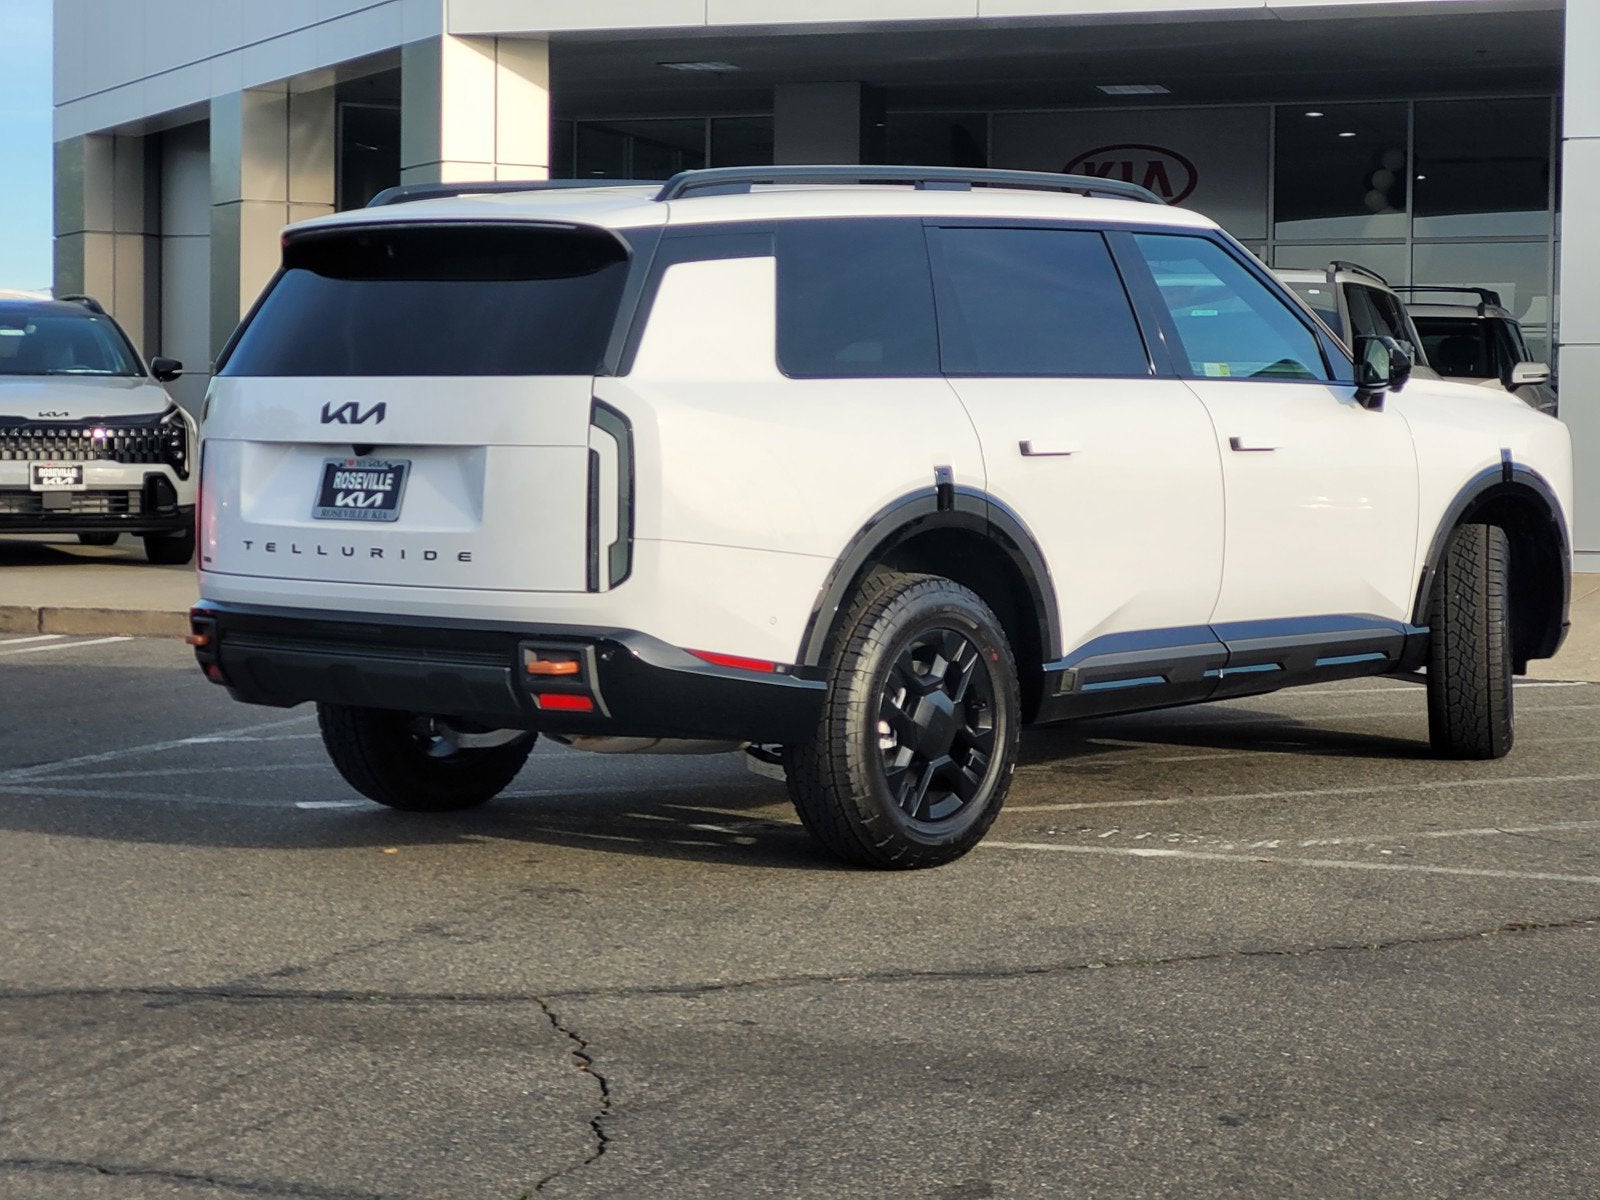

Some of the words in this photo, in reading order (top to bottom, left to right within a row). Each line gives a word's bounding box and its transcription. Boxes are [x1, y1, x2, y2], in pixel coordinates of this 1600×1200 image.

[320, 401, 387, 425] KIA
[333, 471, 394, 491] ROSEVILLE
[335, 491, 384, 507] KIA
[243, 540, 472, 562] TELLURIDE
